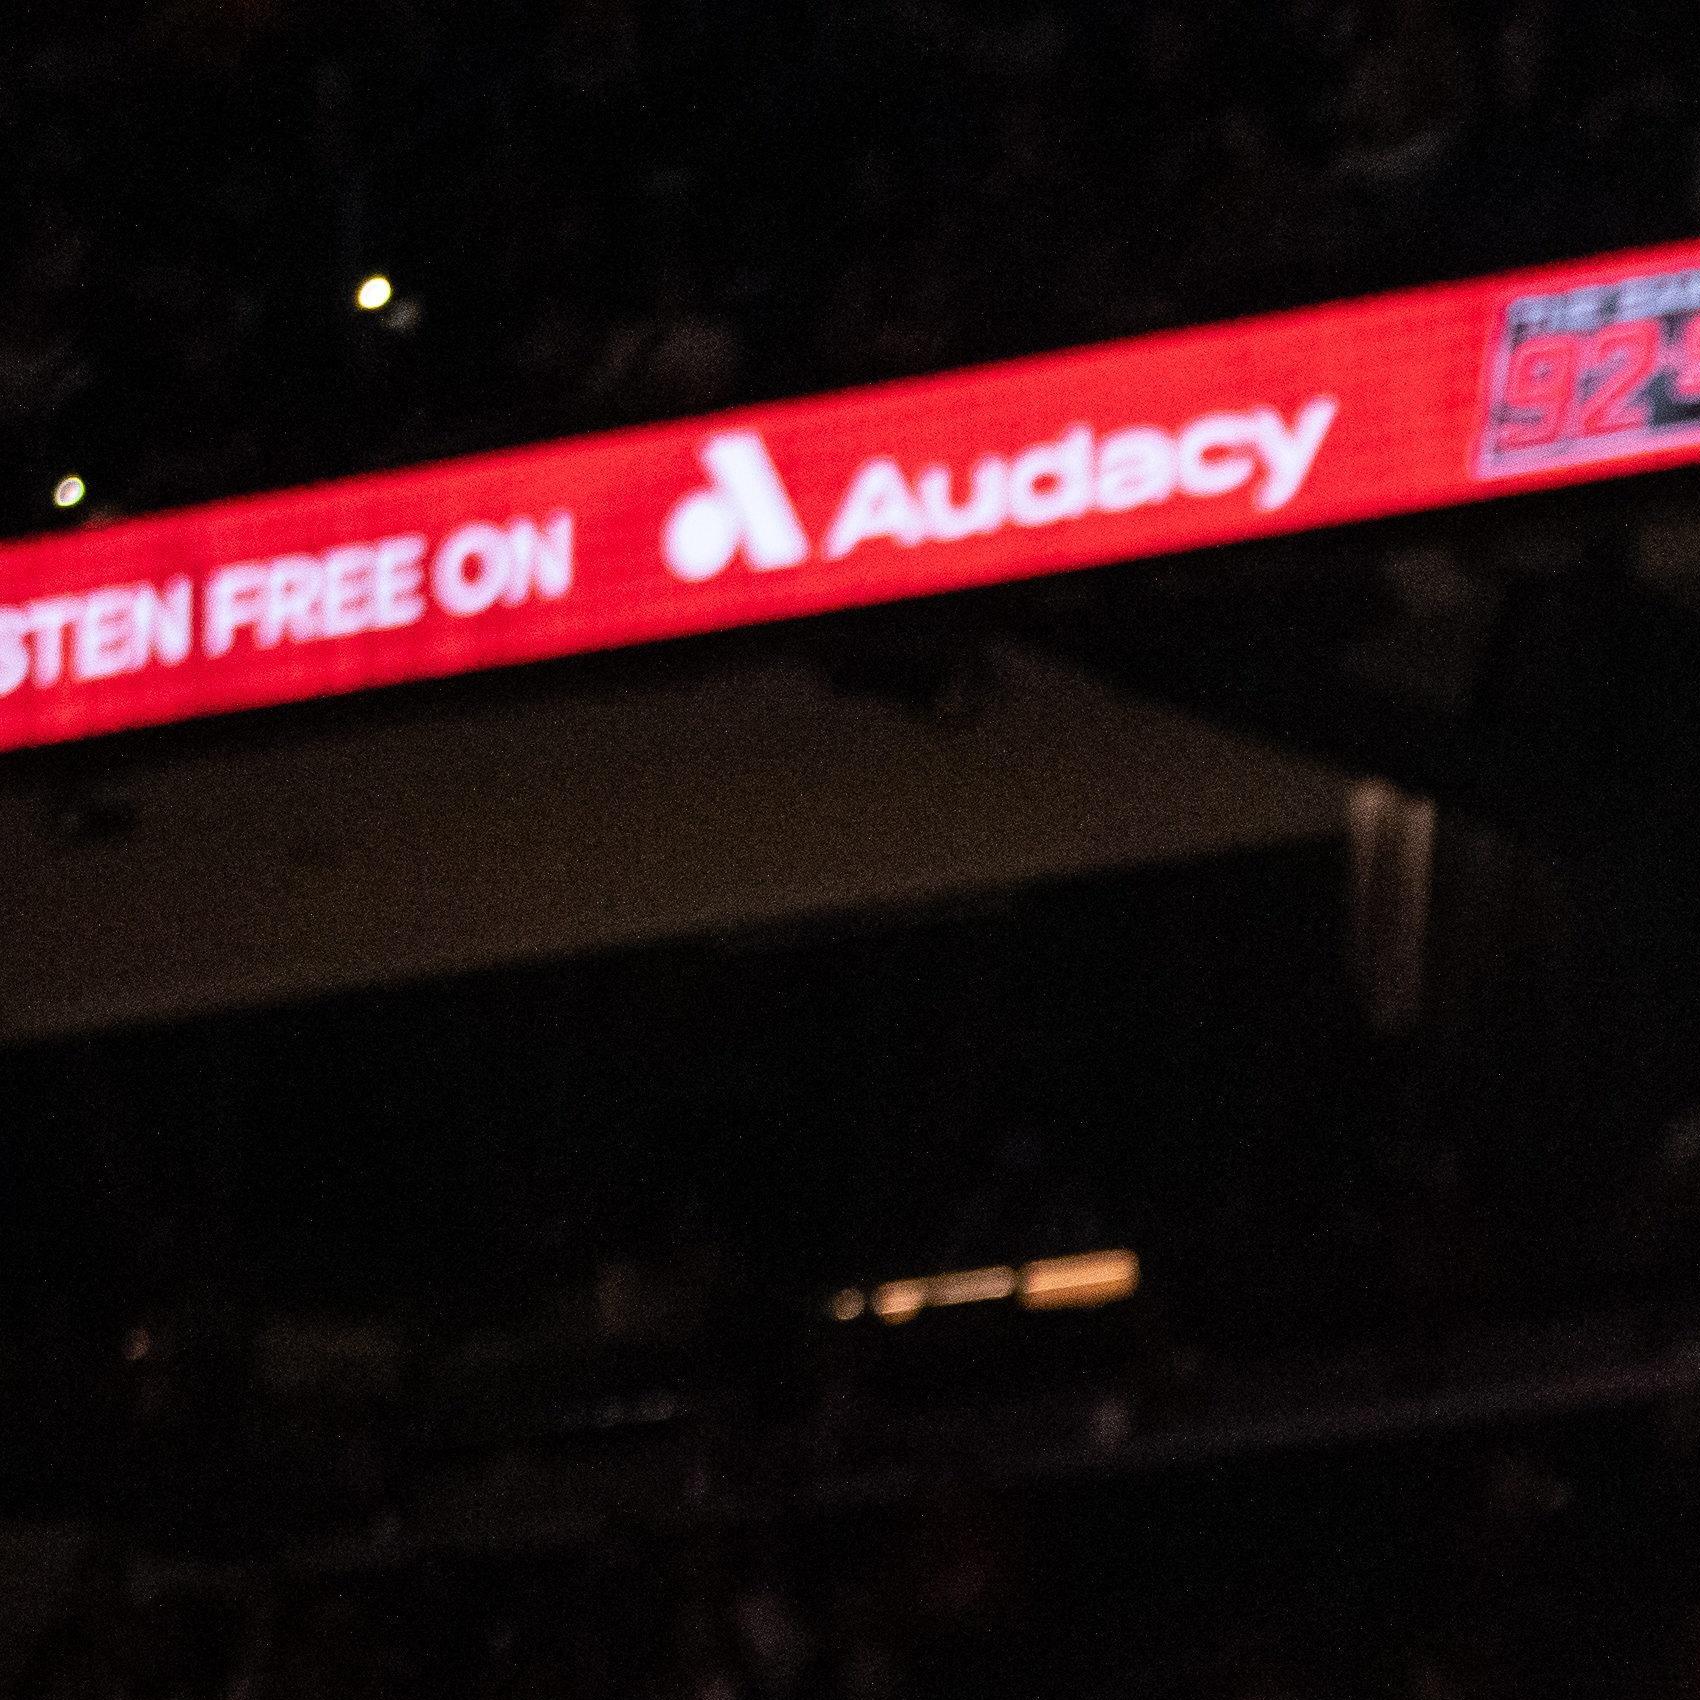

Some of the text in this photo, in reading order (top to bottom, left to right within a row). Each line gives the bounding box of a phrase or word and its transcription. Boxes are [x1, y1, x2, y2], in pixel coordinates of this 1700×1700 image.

[826, 398, 1337, 559] Audacy
[207, 538, 423, 655] FREE
[435, 515, 573, 616] ON
